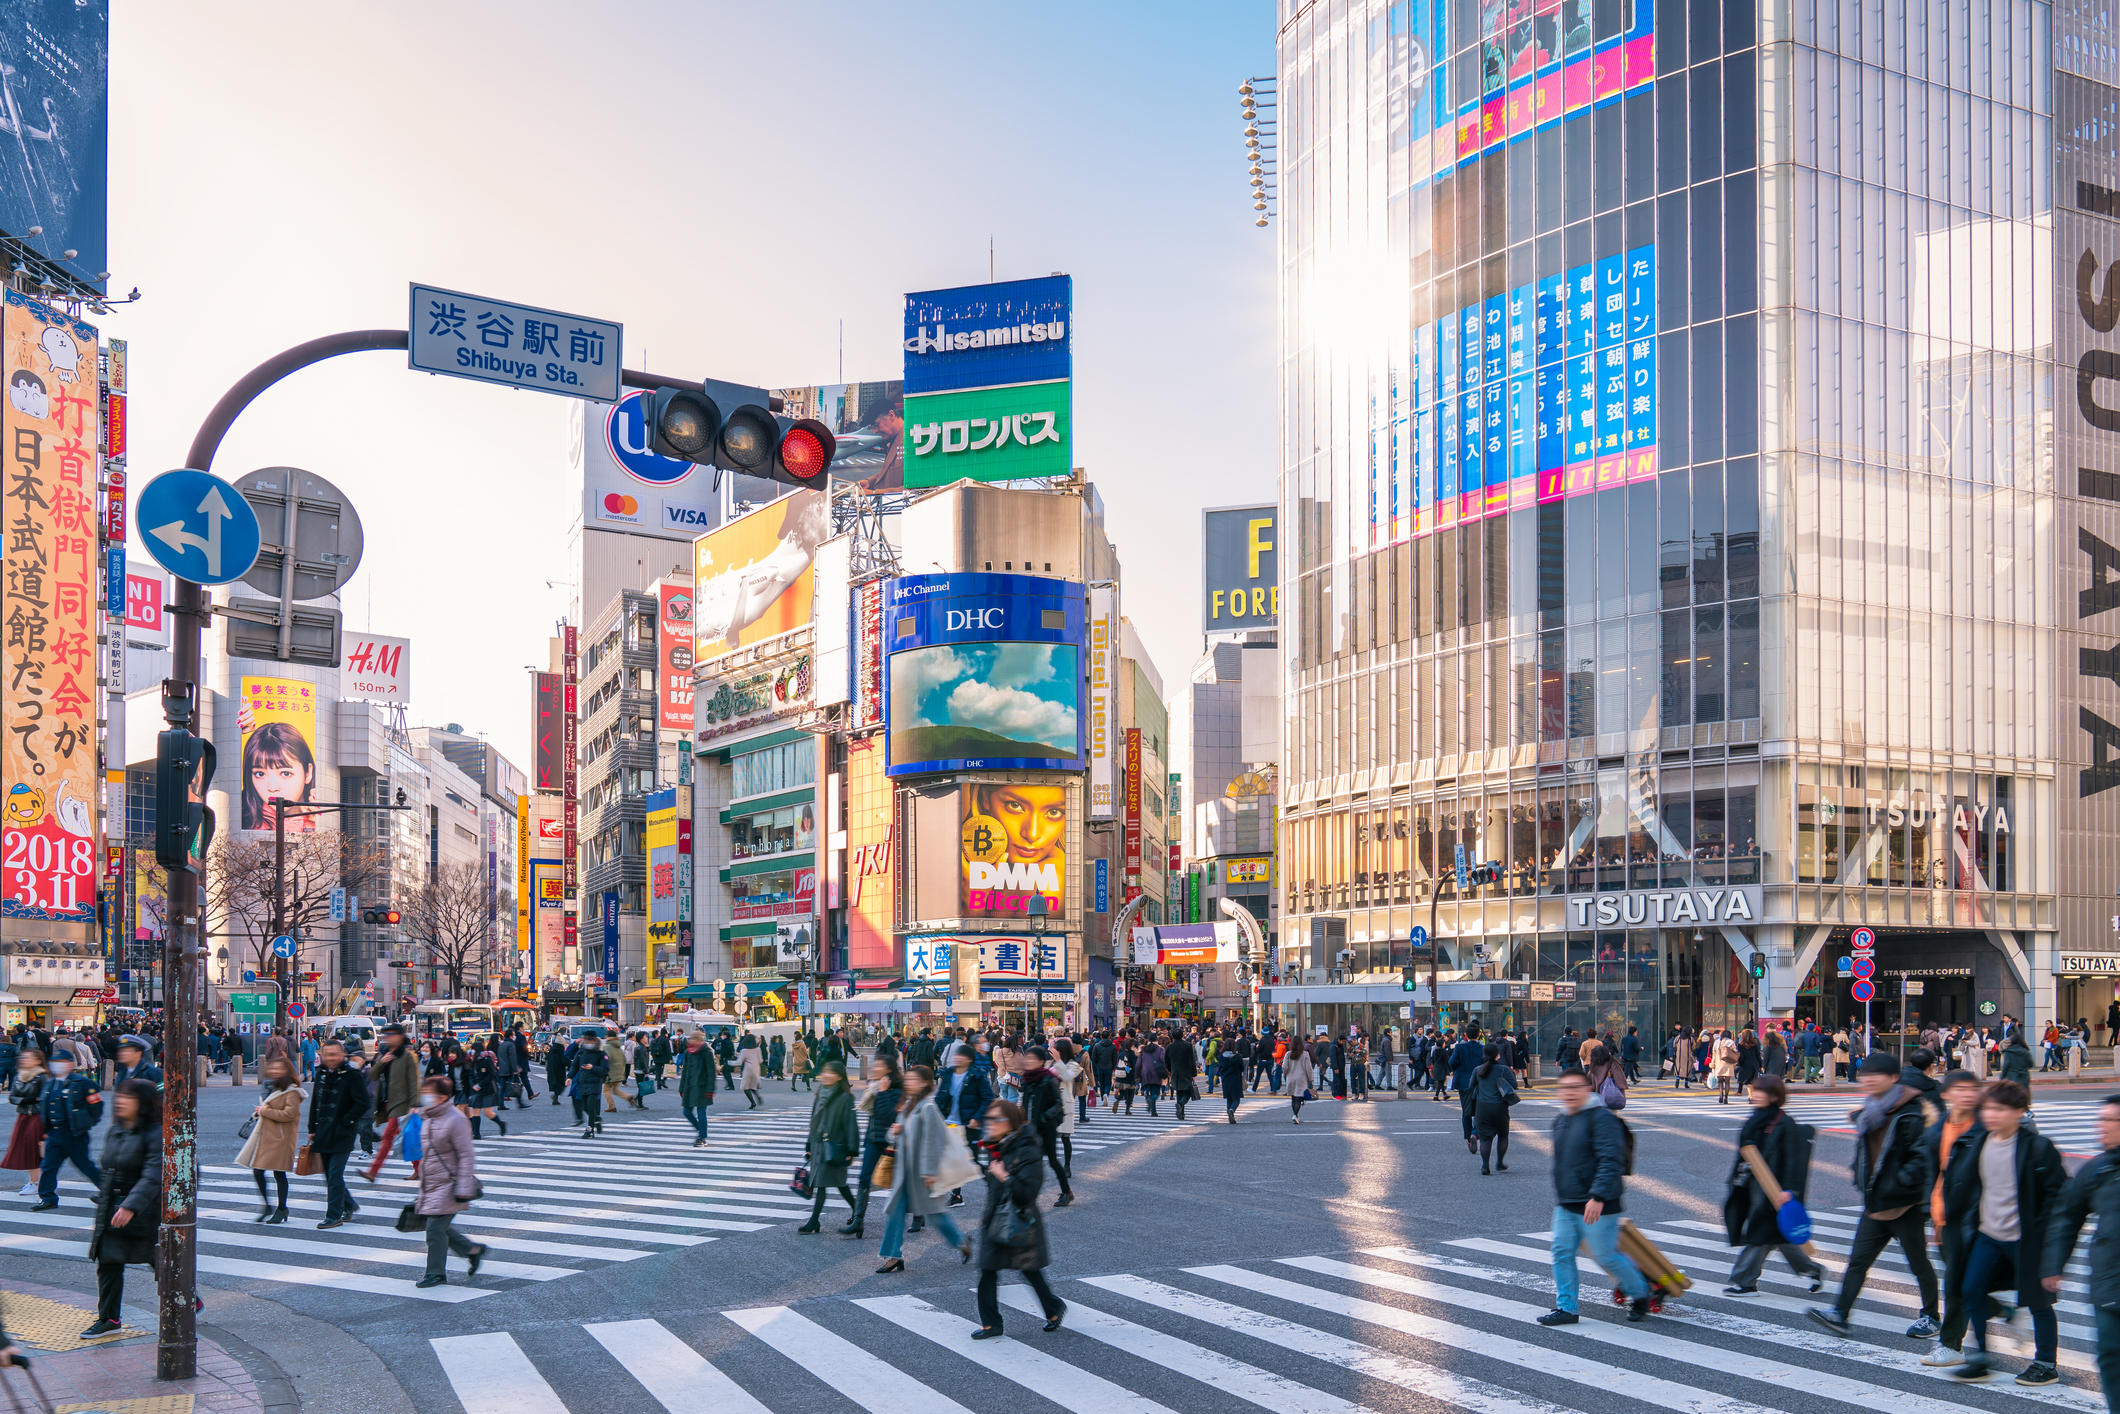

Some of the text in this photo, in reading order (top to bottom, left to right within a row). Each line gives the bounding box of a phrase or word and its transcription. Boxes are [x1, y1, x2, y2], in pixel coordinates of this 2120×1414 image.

[428, 301, 606, 367] 渋谷駅前
[904, 320, 1064, 354] Hisamitsu
[112, 352, 123, 387] しゃぶ葉
[456, 347, 585, 387] Shibuya Sta.
[910, 410, 1060, 456] サロンパス
[111, 500, 123, 532] ガスト
[605, 514, 638, 524] mastercard
[666, 505, 708, 527] VISA
[48, 384, 93, 760] 打首獄門同好会が
[6, 425, 50, 776] 日本武道館だって。
[128, 581, 151, 602] NI
[894, 581, 950, 600] DHC Channel
[128, 601, 155, 622] LO
[945, 607, 1004, 631] DHC
[111, 629, 121, 688] 渋谷駅前ビル
[347, 641, 402, 678] H&M
[552, 674, 560, 711] TOKYO
[1092, 612, 1109, 759] Taisei neon
[540, 673, 551, 787] KATE
[1128, 732, 1139, 812] クスリのことなら
[1866, 797, 2010, 832] TSUTAYA
[4, 831, 93, 876] 2018
[519, 815, 528, 884] Matsumoto KiYoshi
[679, 832, 692, 840] JTB
[735, 835, 791, 856] Euphoria
[1127, 819, 1140, 868] 三千里
[15, 868, 80, 912] 3.11
[546, 881, 563, 898] 薬
[652, 861, 675, 899] 薬
[797, 873, 815, 895] JTB
[969, 861, 1059, 891] DMM
[608, 900, 616, 927] MIZUHO
[968, 890, 1059, 912] Bitcon
[1571, 889, 1753, 926] TSUTAYA
[607, 945, 615, 975] みずほ銀行
[912, 943, 1057, 972] 大盛書店
[2062, 957, 2117, 970] TSUTAYA
